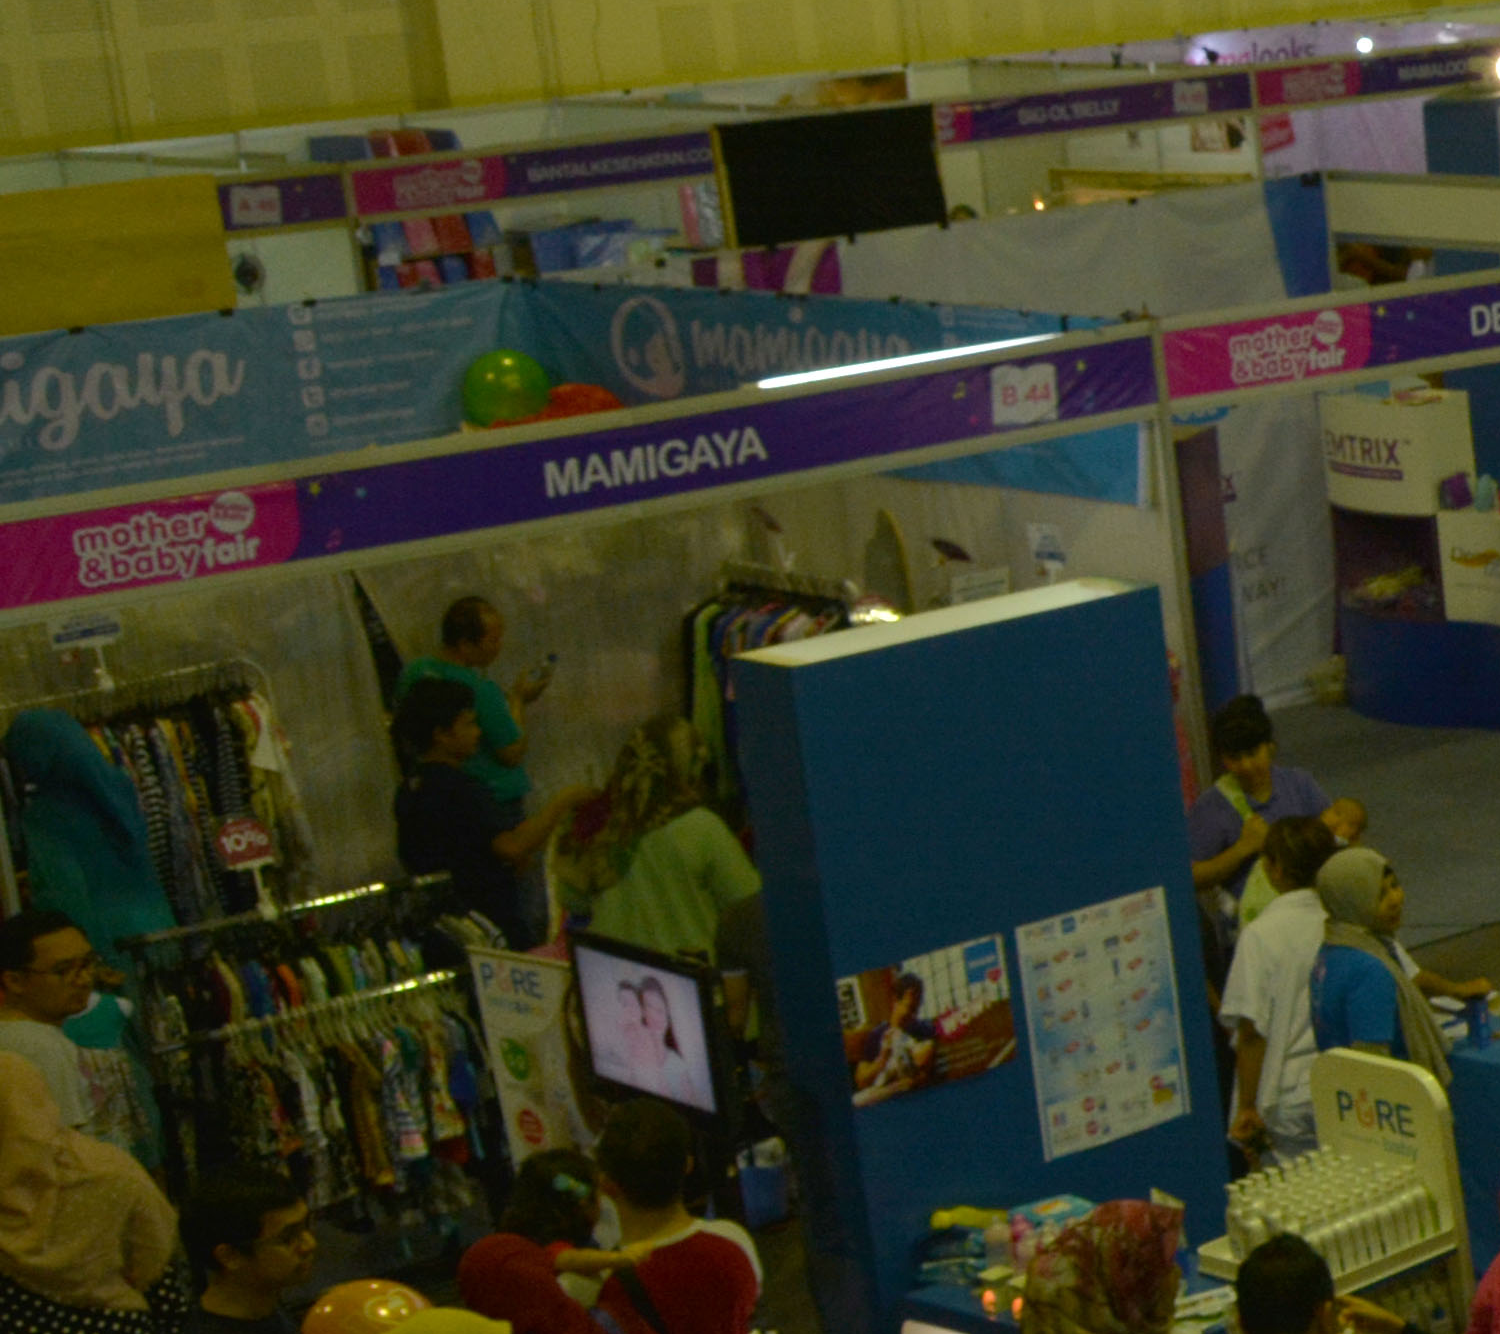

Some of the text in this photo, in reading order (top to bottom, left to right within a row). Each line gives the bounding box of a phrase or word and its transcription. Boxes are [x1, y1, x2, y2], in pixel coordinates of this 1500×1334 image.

[1230, 324, 1316, 361] mother
[1233, 344, 1345, 384] &baby fair
[545, 426, 767, 498] MAMIGAYA
[74, 513, 206, 558] mother
[77, 523, 262, 588] &baby fair
[1336, 1089, 1416, 1138] PURE
